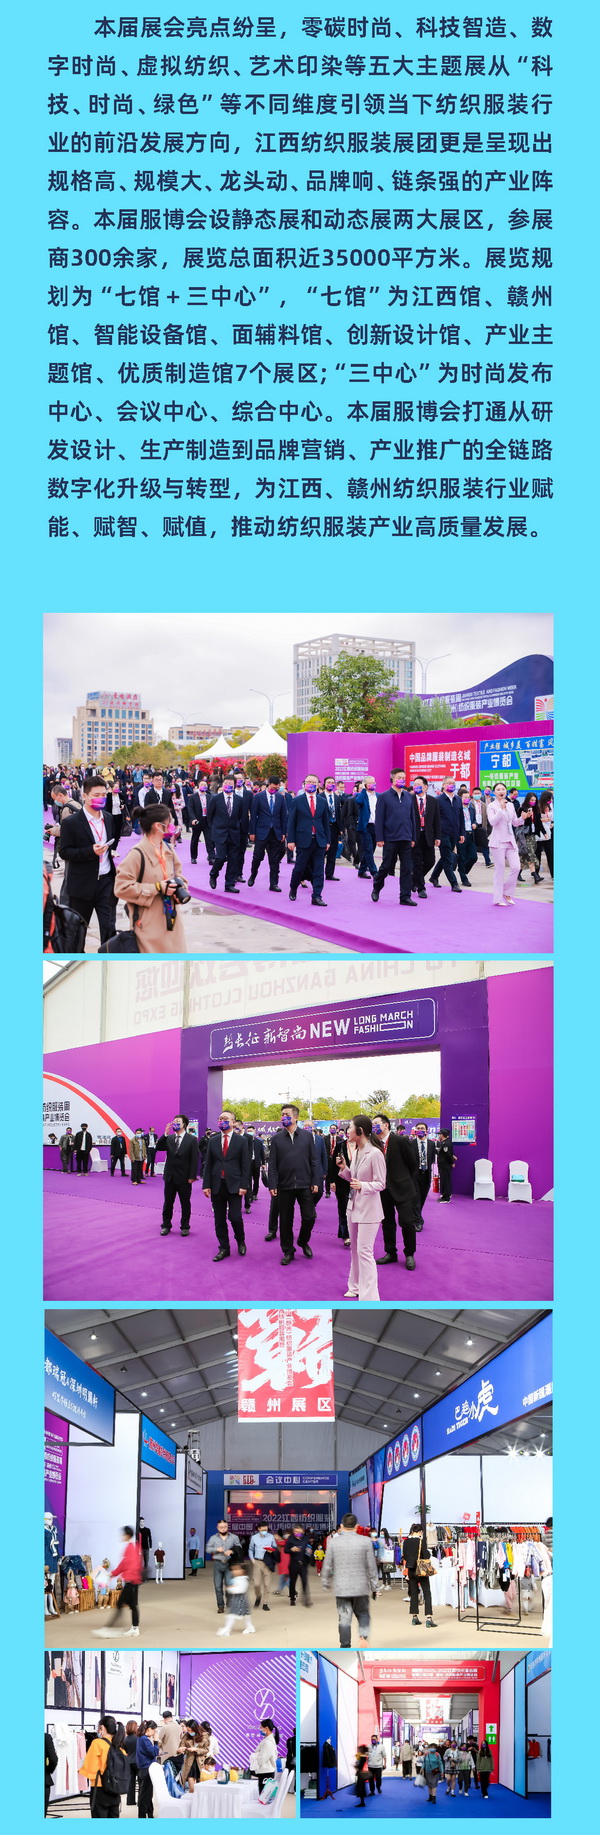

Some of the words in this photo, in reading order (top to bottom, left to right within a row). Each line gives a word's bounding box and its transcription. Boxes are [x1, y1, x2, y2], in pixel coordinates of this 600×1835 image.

[491, 753, 512, 768] 宁都
[353, 1014, 377, 1026] LONG
[380, 1010, 413, 1022] MARCH
[310, 1018, 351, 1039] NEW
[241, 1397, 332, 1413] 赣州展区
[266, 1475, 301, 1484] 会议中心
